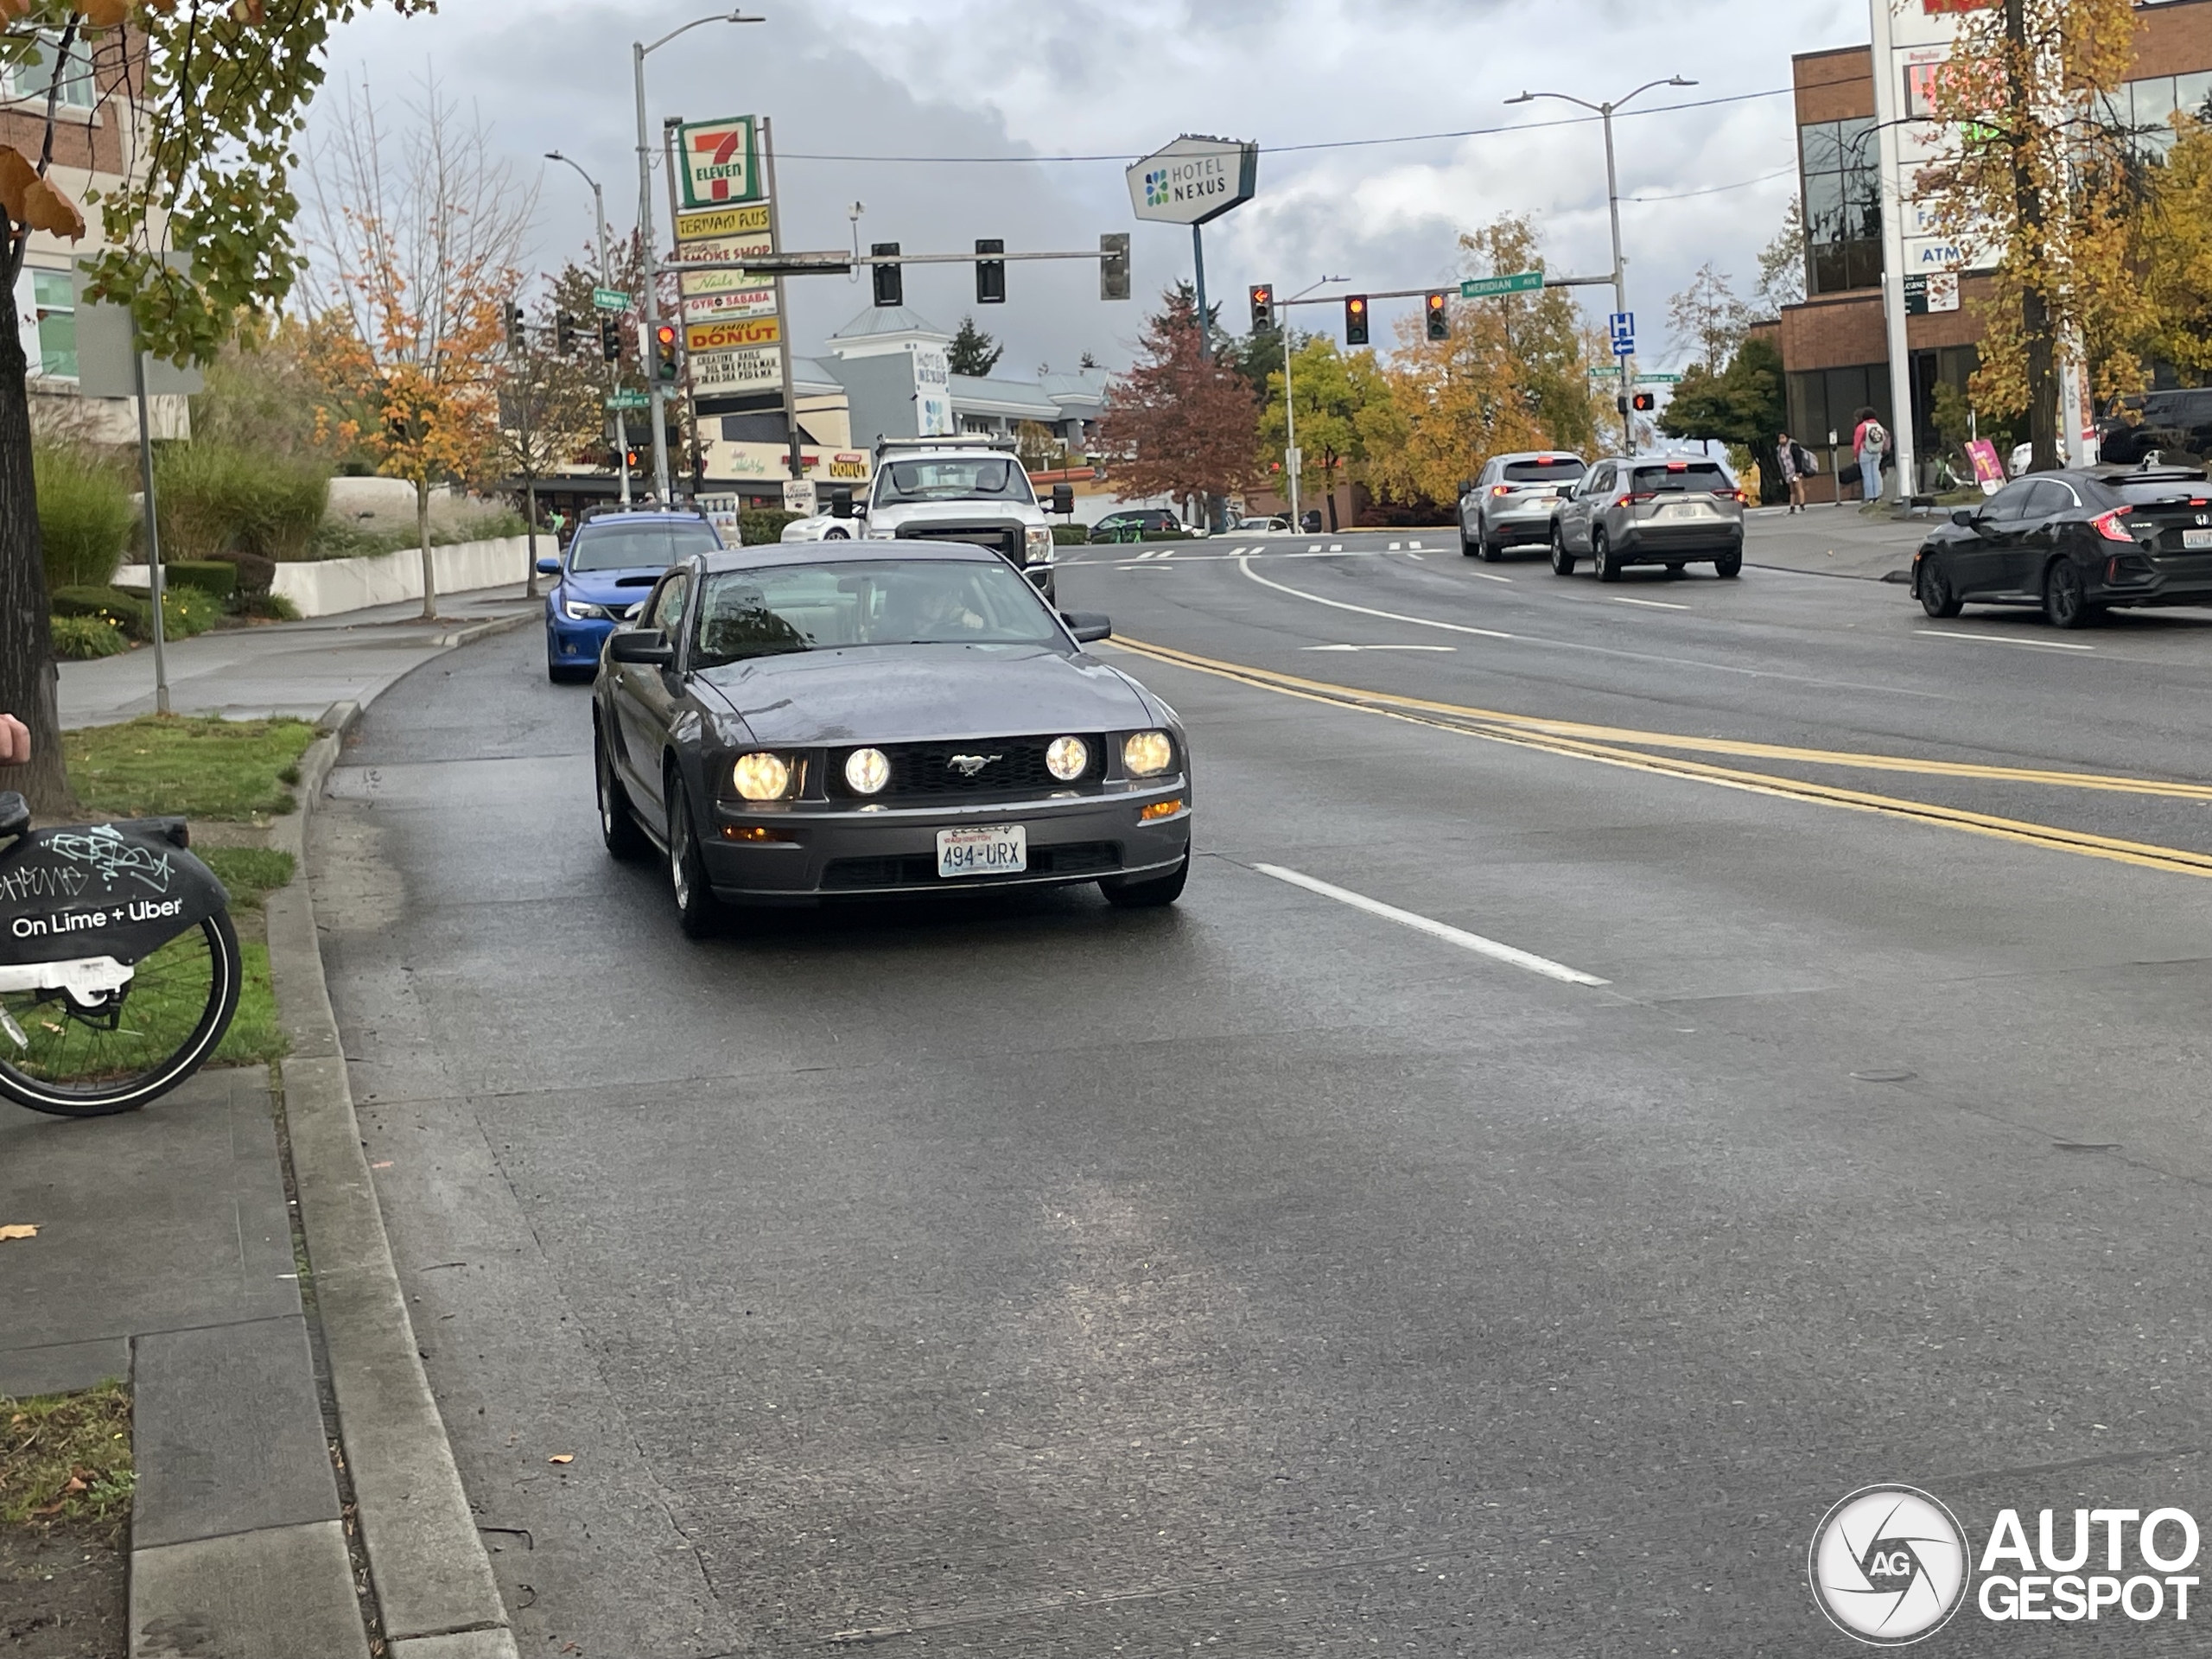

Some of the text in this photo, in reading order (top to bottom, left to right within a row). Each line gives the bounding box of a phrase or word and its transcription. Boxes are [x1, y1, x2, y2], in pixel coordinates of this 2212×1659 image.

[695, 130, 739, 200] 7
[1173, 157, 1224, 182] HOTEL
[1174, 177, 1225, 202] NEXUS
[679, 210, 768, 234] TERIYAKI PLUS
[683, 248, 730, 261] SMOKE
[734, 245, 771, 259] SHOP
[1922, 246, 1960, 262] ATM
[693, 273, 733, 291] Nails
[1466, 279, 1511, 293] MERIDIAN
[726, 292, 769, 306] SABABA
[711, 321, 754, 333] FAMILY
[1612, 314, 1632, 336] H
[692, 327, 777, 347] DONUT
[696, 350, 760, 365] CREATIVE NAILS
[830, 462, 868, 478] DONUT
[944, 834, 991, 844] WASHINGTON
[944, 842, 1019, 868] 494-URX
[12, 918, 48, 938] On
[52, 912, 107, 933] Lime
[130, 899, 180, 921] Uber
